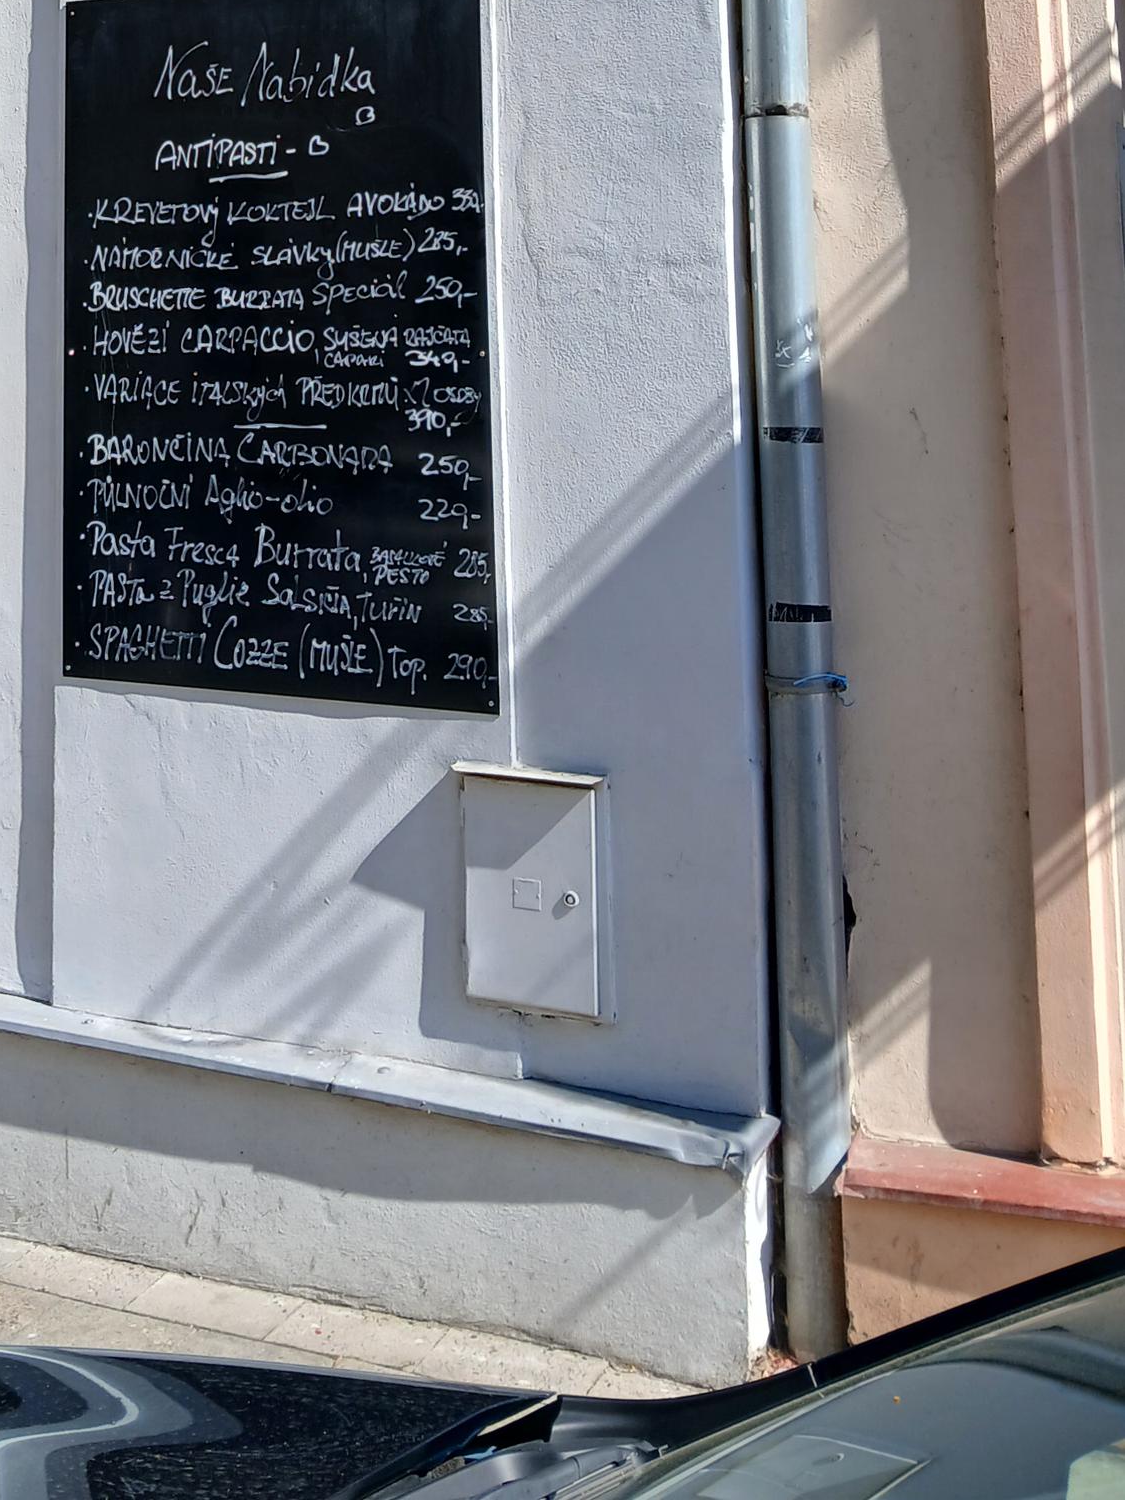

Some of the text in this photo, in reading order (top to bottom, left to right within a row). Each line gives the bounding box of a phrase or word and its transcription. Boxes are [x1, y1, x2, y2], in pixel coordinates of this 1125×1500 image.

[155, 133, 282, 171] ANTIPASTI
[227, 195, 336, 226] KOKTEJL
[346, 182, 445, 221] AVOKÁDO
[87, 280, 207, 312] BRUSCHETTE
[213, 285, 305, 311] BURRATA
[92, 320, 171, 357] HOVĚZÍ
[93, 370, 182, 411] VARIACE
[237, 431, 394, 475] CARBONARA
[86, 520, 156, 558] Pasta
